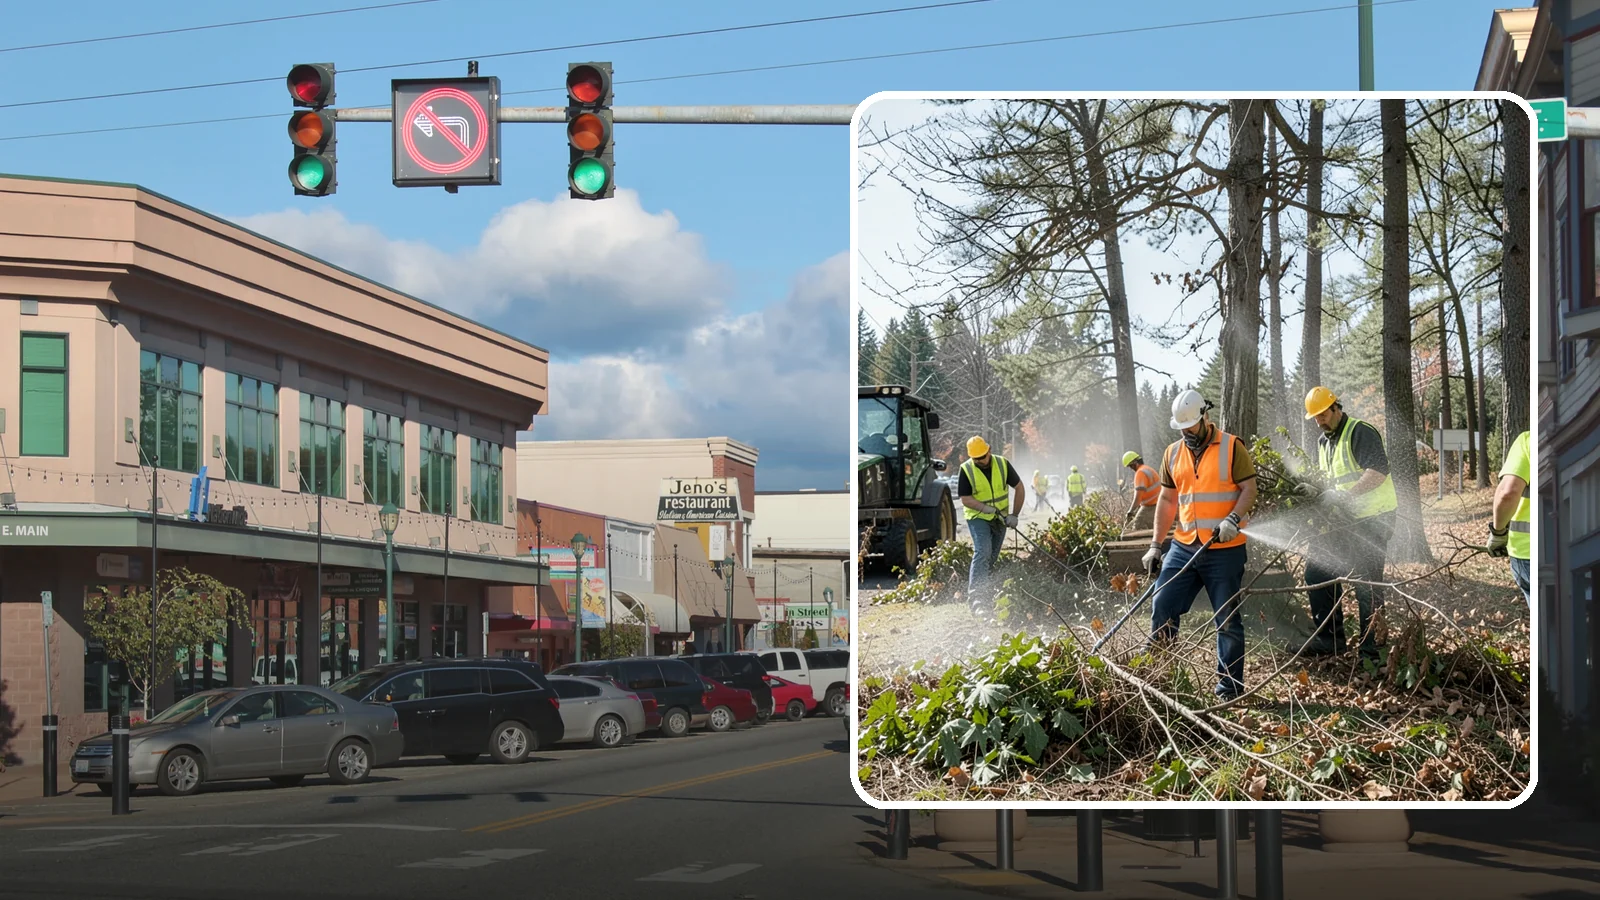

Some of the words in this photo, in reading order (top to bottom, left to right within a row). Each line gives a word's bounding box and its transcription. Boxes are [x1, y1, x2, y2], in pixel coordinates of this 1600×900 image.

[669, 480, 728, 495] Jeno's
[665, 496, 731, 509] restaurant
[658, 510, 682, 520] Italian
[686, 510, 715, 519] American
[715, 510, 737, 519] Cuisine
[2, 525, 13, 536] E.
[15, 525, 49, 536] MAIN
[797, 607, 828, 617] Street
